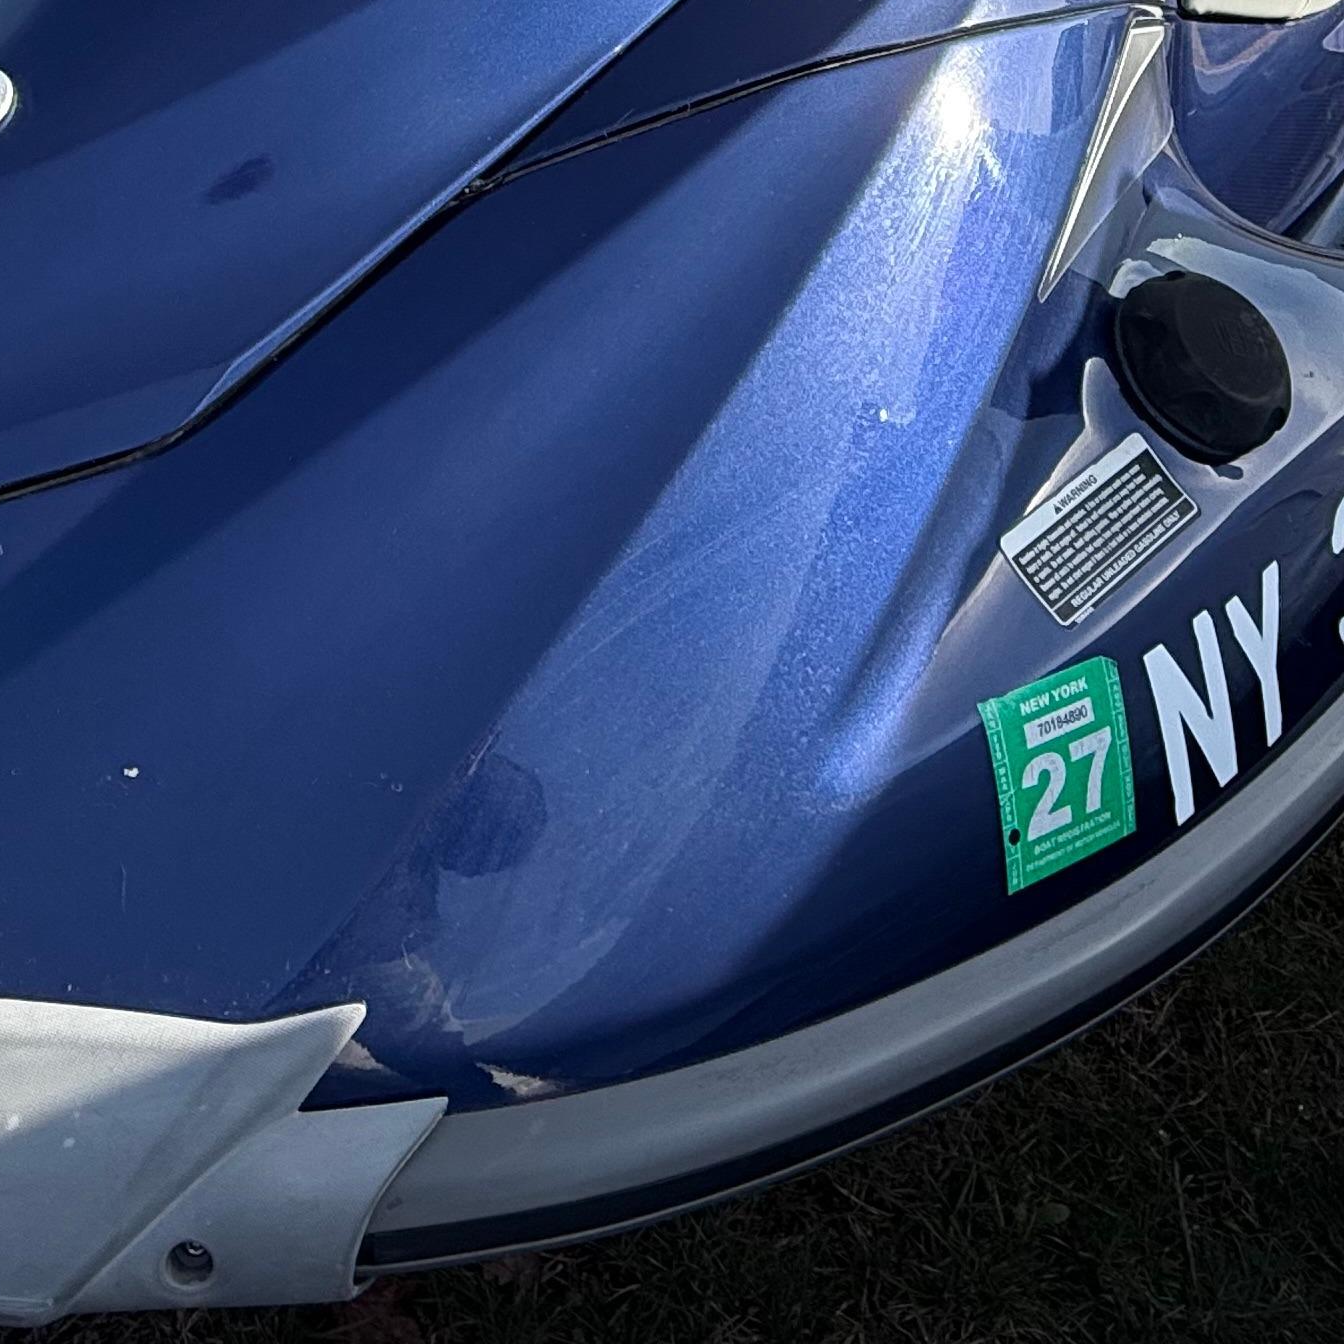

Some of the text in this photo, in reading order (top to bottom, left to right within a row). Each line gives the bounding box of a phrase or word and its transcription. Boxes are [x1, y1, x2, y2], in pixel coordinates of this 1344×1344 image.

[1058, 474, 1098, 510] WARNING
[1070, 510, 1181, 608] REGULAR UNLEADED GASOLINE ONLY
[1019, 676, 1088, 716] NEW YORK
[1143, 560, 1280, 827] NY
[1022, 726, 1113, 842] 27
